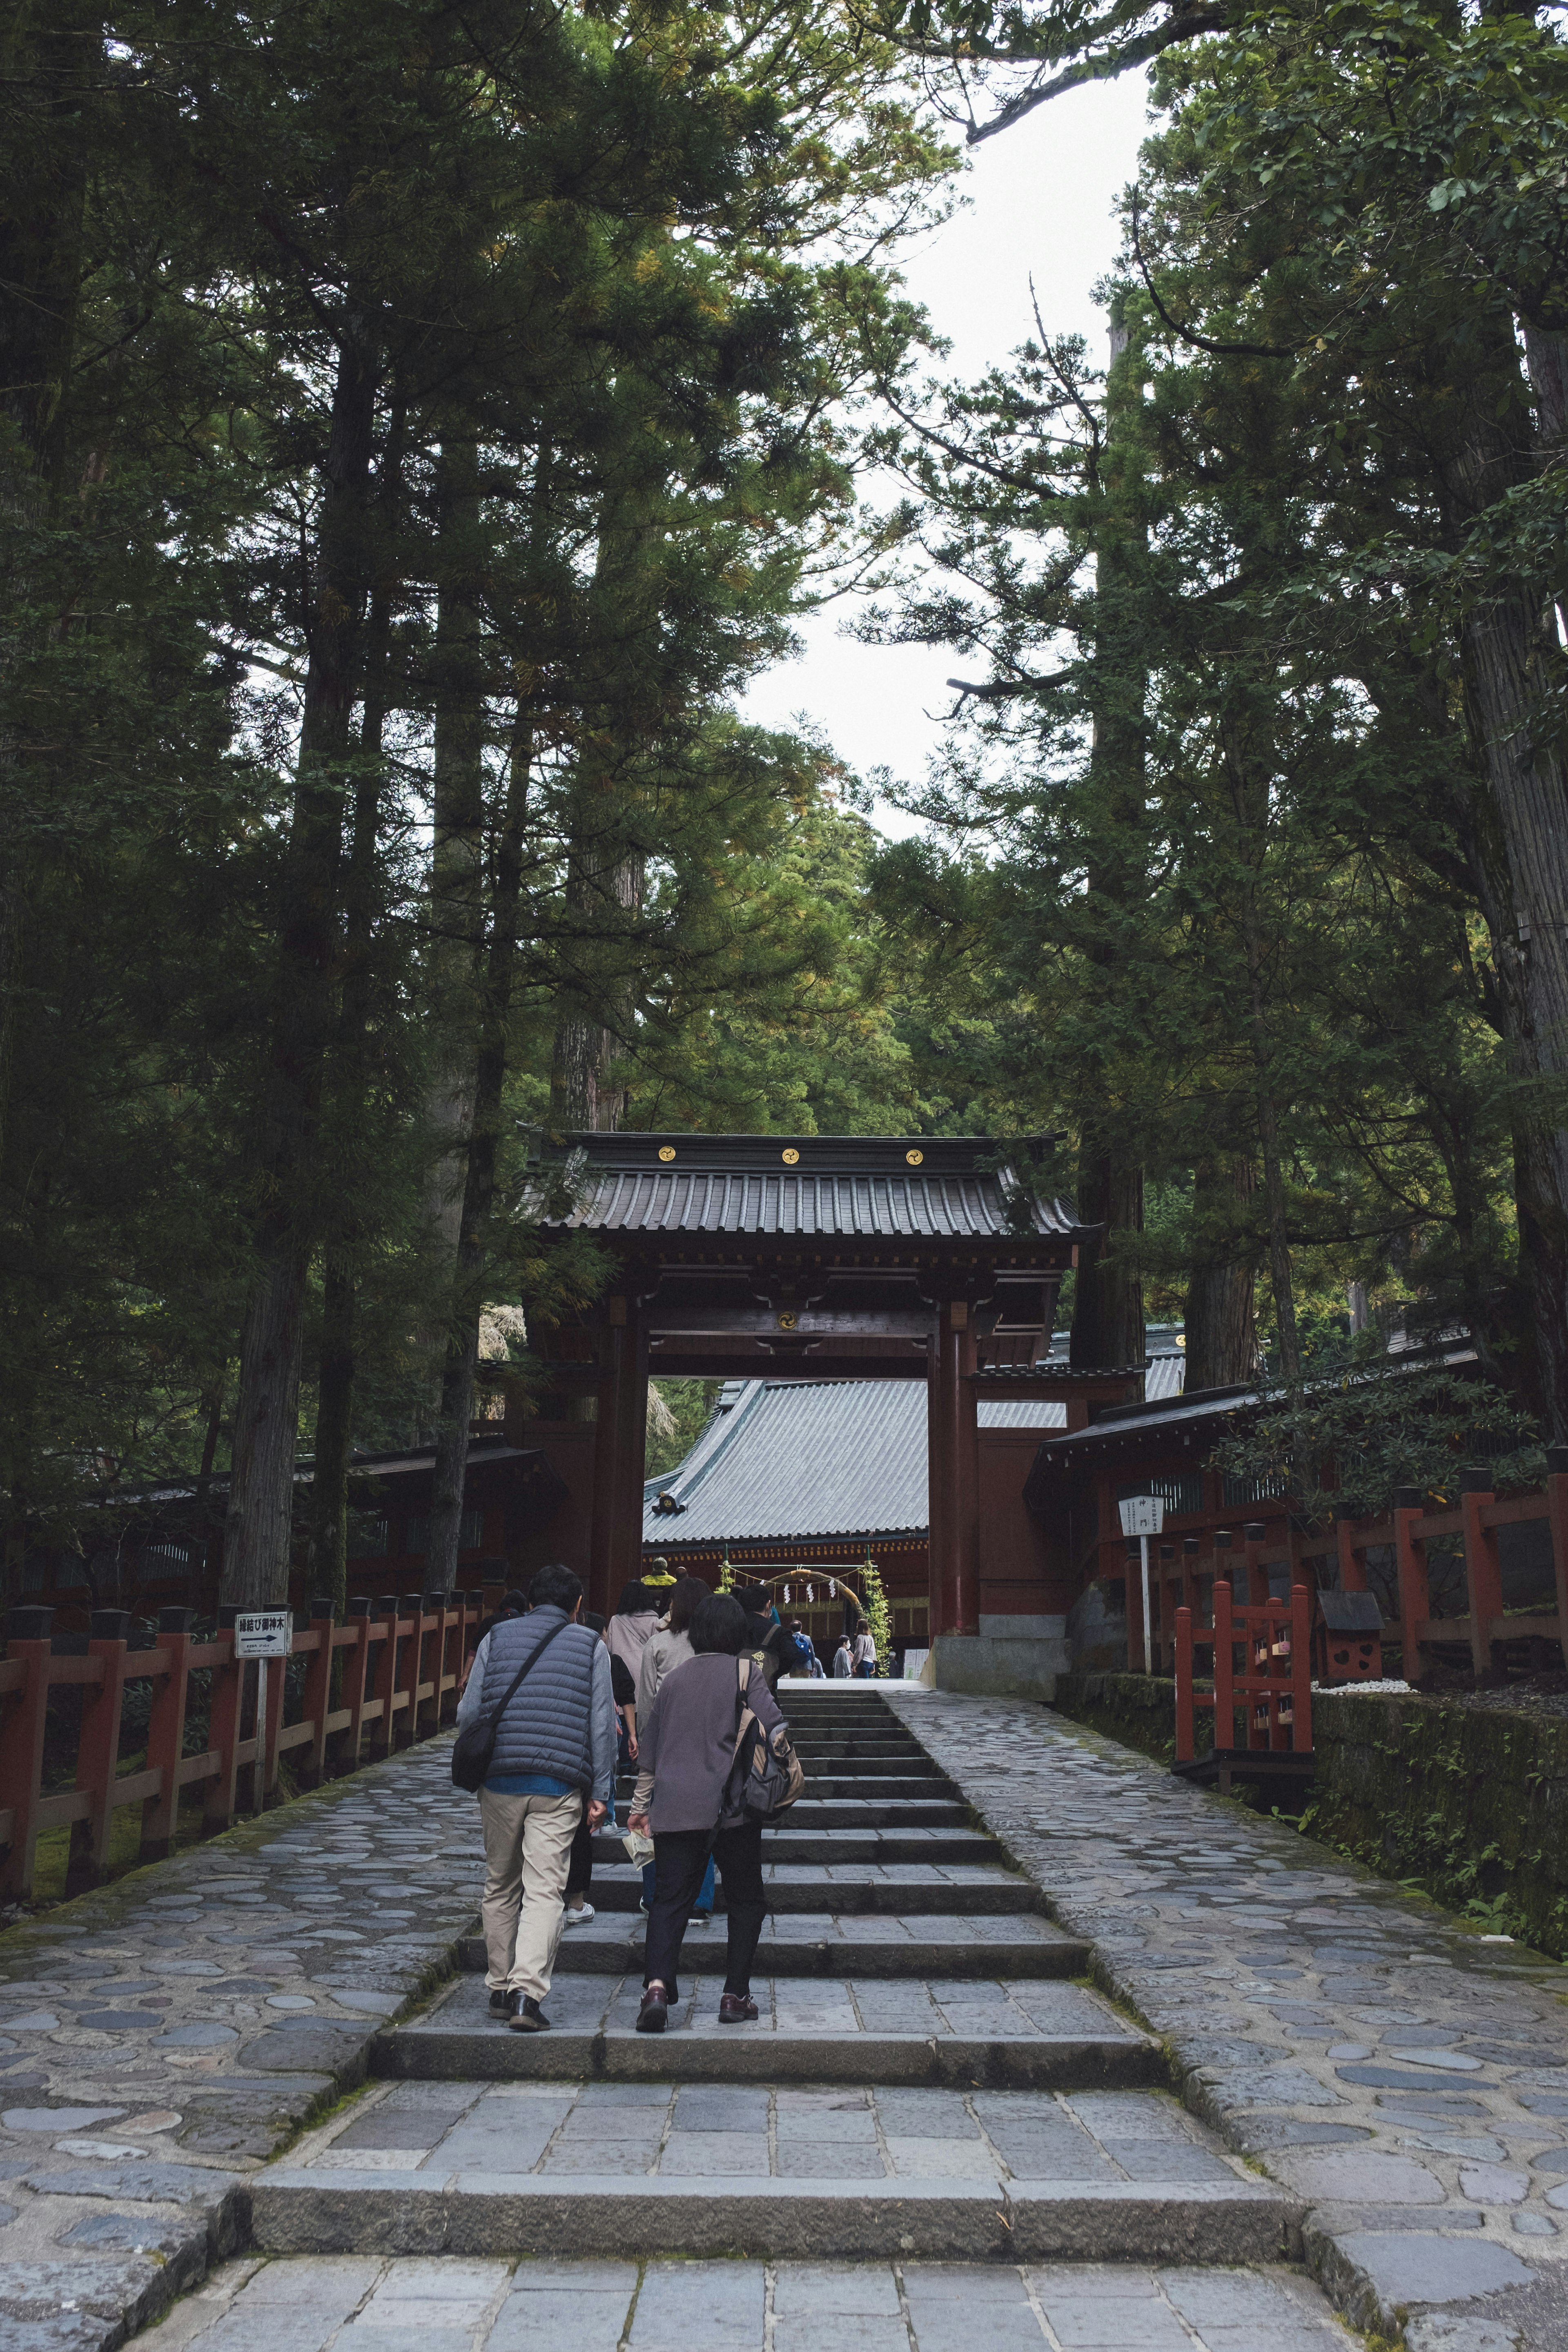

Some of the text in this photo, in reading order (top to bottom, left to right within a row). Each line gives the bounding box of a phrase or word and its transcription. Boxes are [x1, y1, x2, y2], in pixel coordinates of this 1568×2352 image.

[1139, 1499, 1147, 1526] 神門
[239, 1617, 284, 1632] 縁結び御神木
